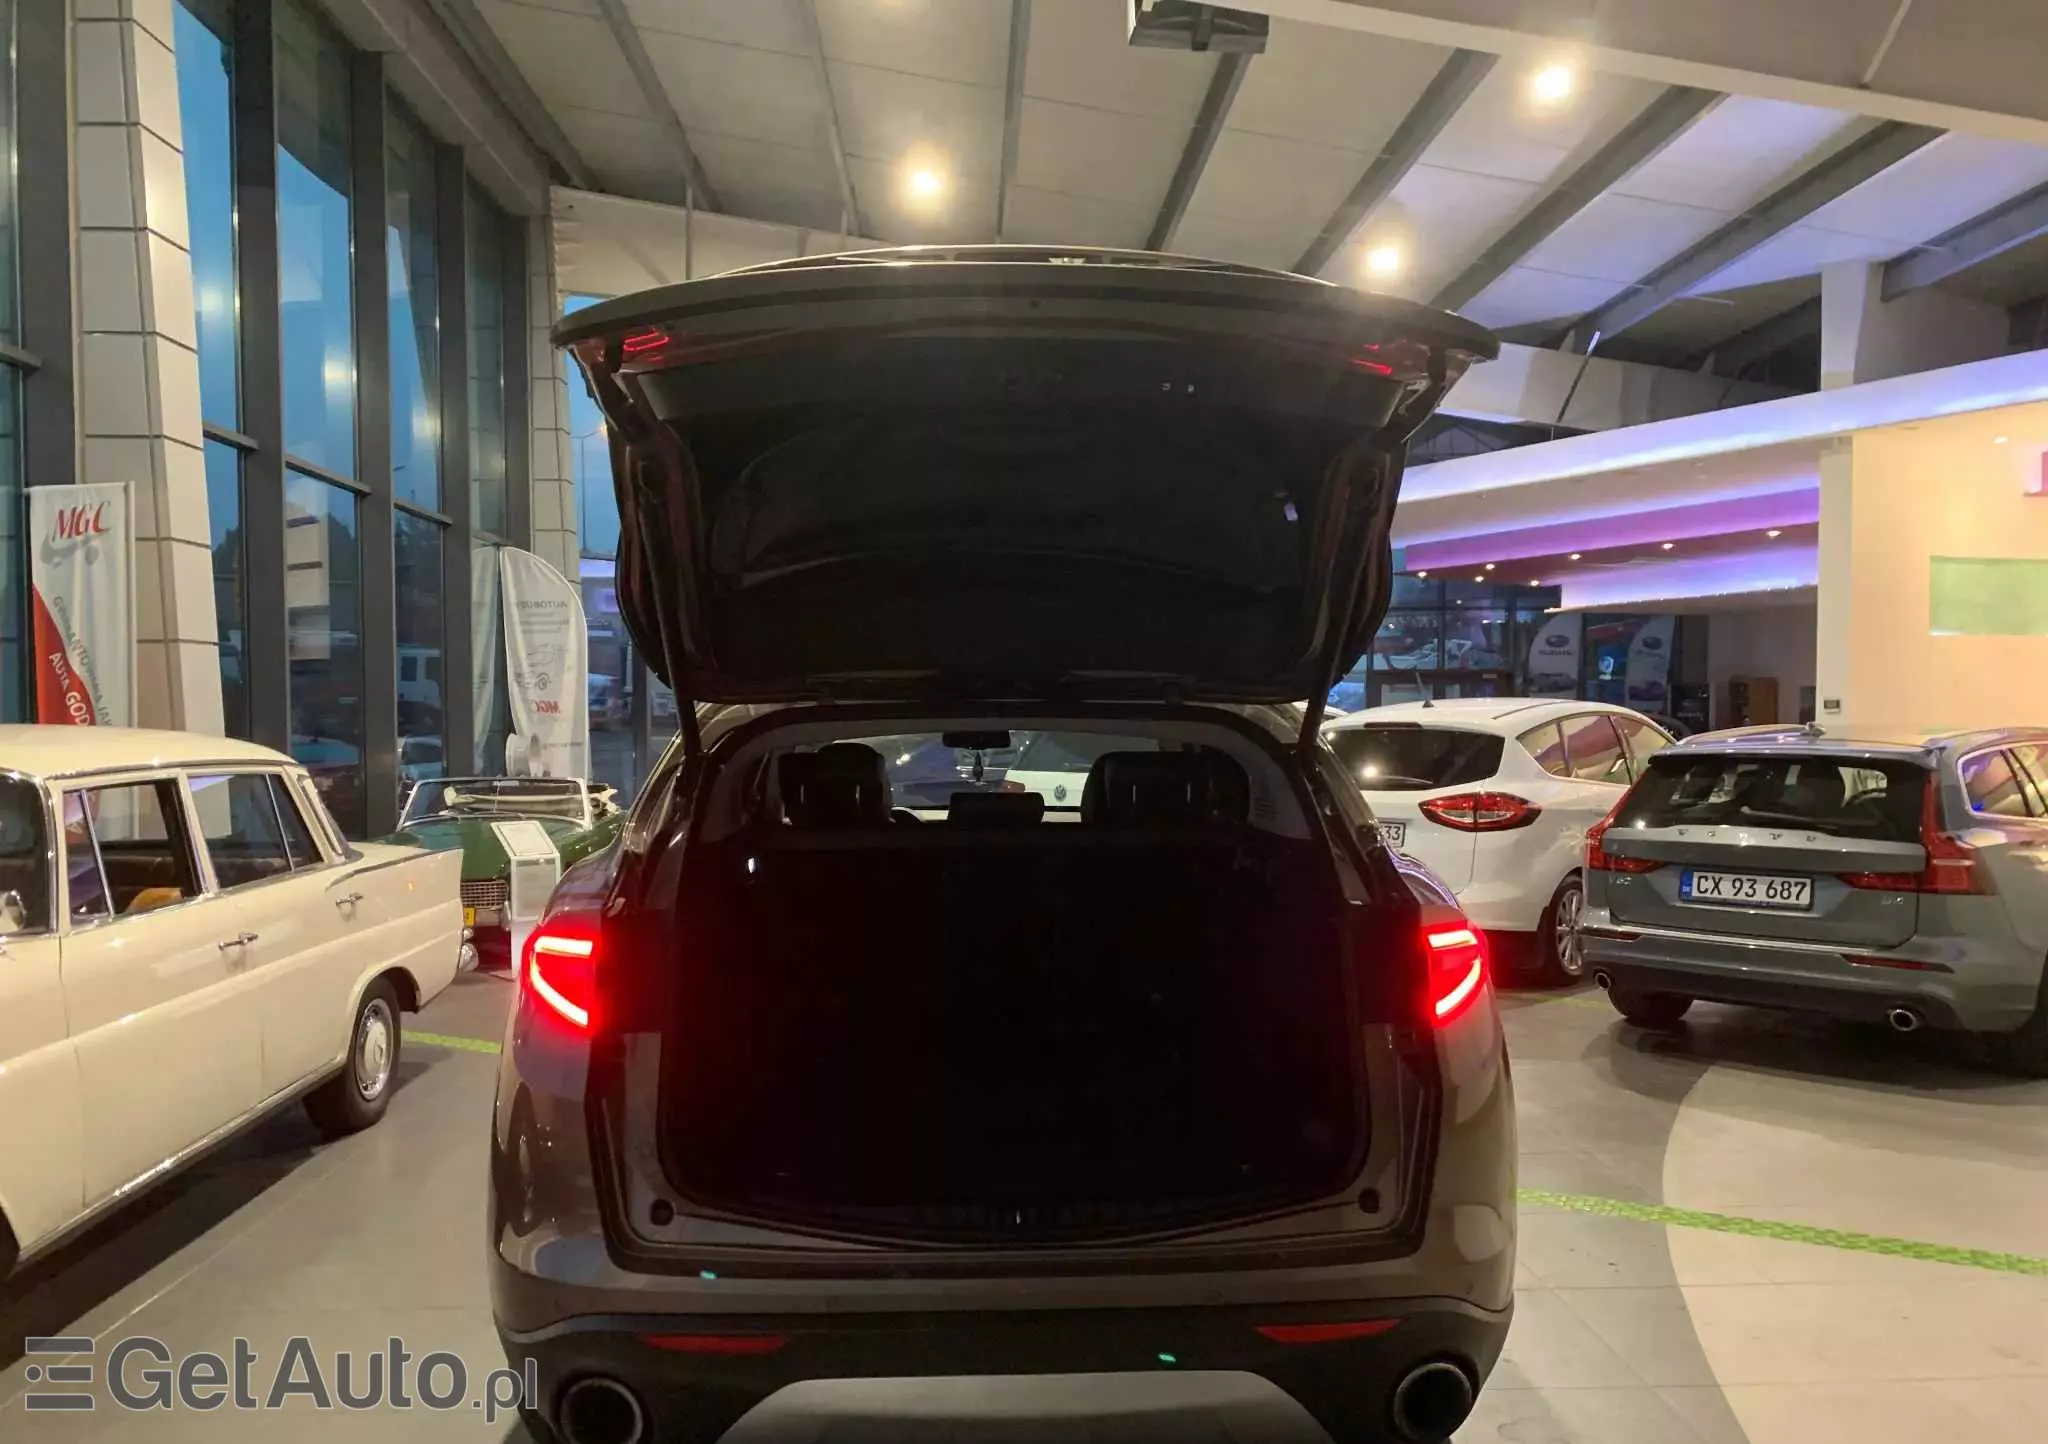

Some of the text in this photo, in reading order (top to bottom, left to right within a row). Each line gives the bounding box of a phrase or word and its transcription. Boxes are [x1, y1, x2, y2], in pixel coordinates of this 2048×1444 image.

[52, 500, 111, 543] MGC
[1696, 875, 1808, 902] CX 93 687
